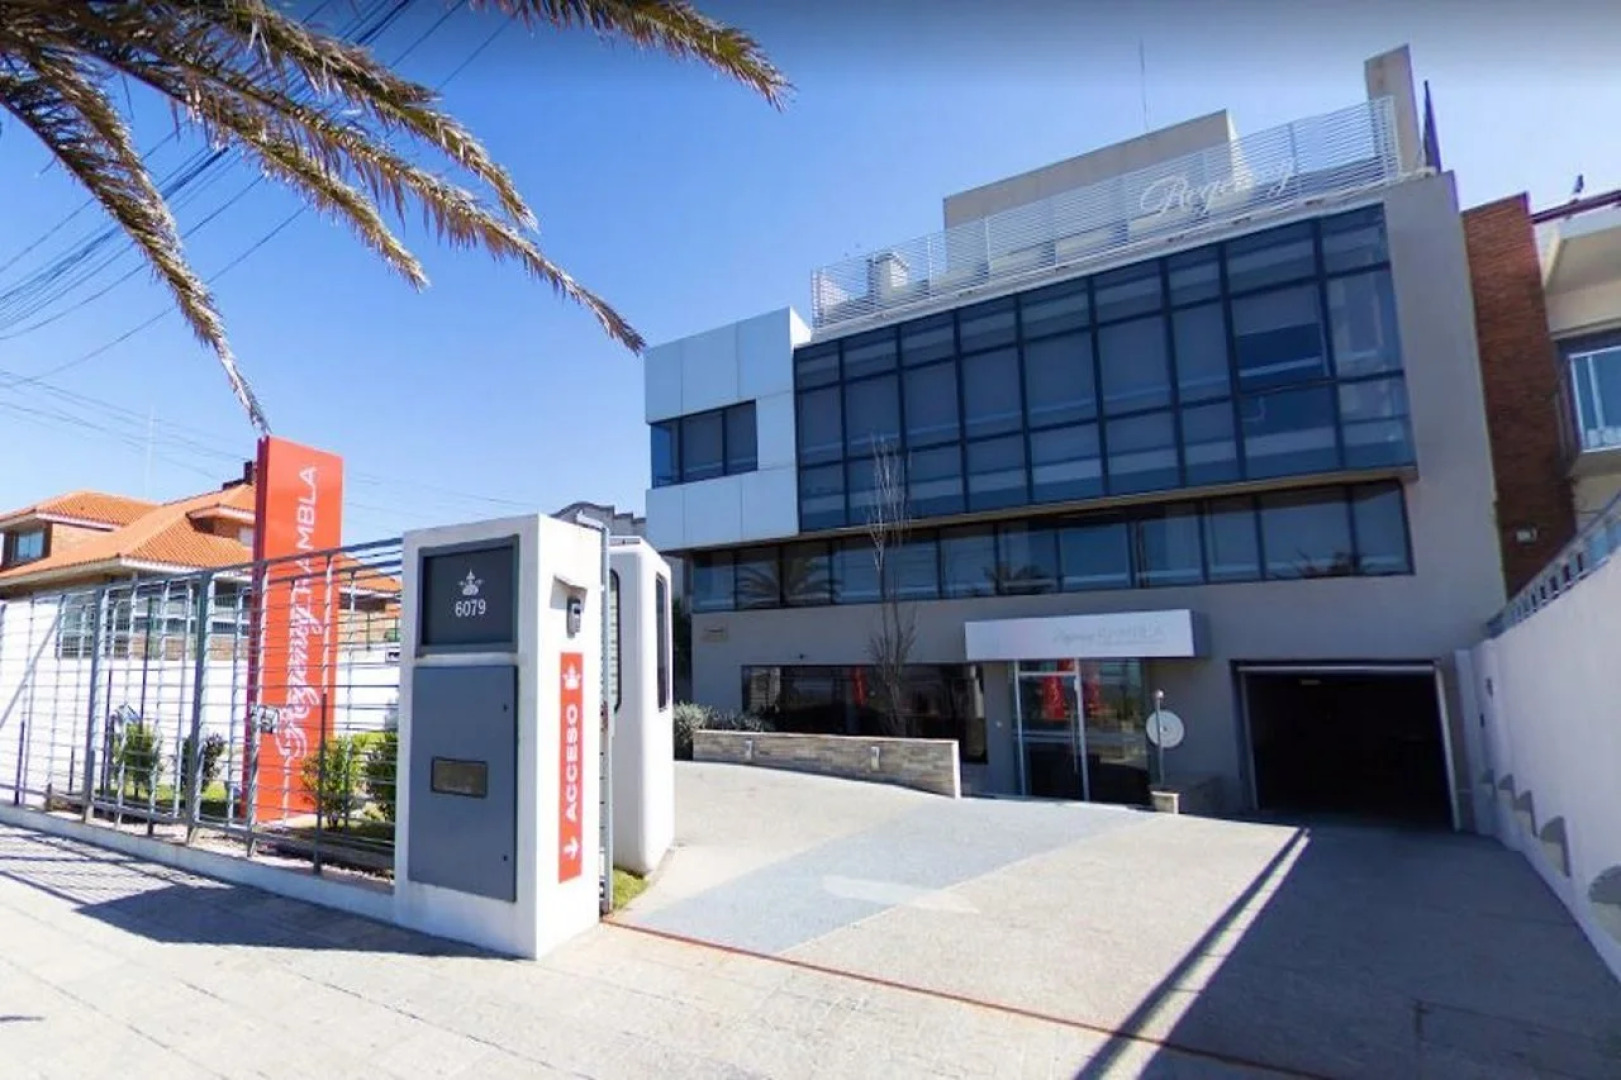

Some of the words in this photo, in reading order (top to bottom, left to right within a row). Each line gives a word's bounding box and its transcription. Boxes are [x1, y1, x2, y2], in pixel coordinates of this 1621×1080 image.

[296, 465, 317, 595] RAMBLA
[455, 599, 486, 617] 6079
[565, 704, 579, 821] ACCESO
